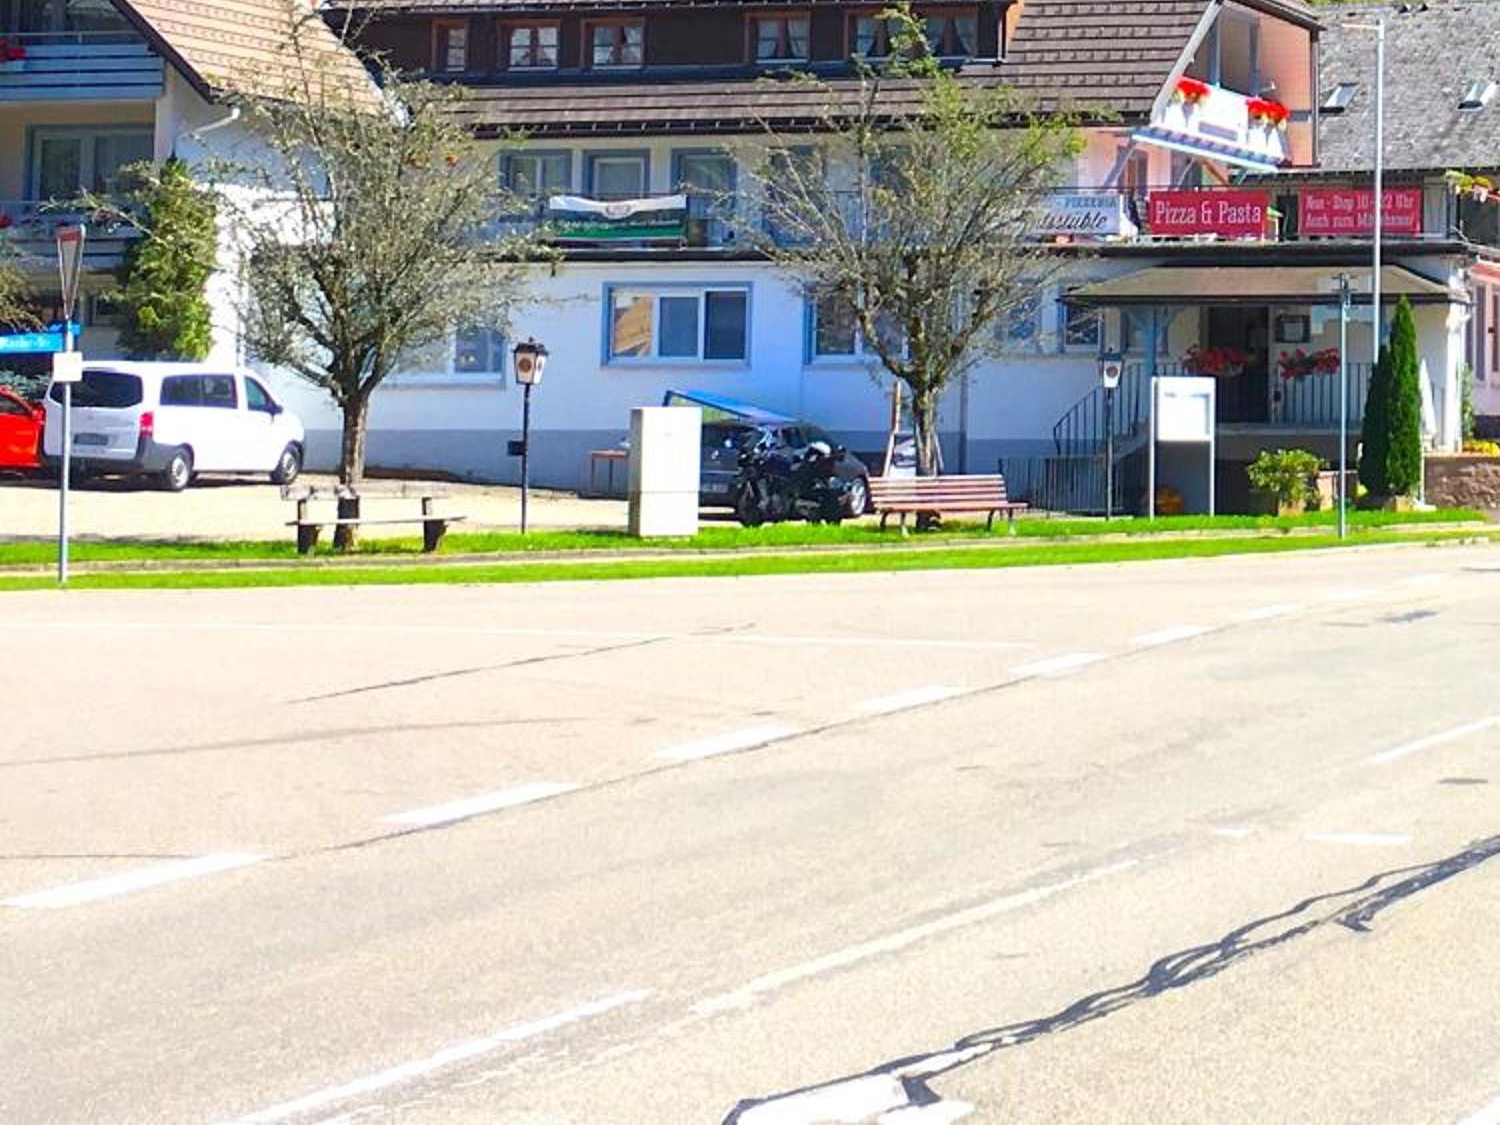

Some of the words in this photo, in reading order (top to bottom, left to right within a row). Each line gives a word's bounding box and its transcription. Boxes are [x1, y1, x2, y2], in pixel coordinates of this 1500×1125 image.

[1155, 200, 1197, 224] Pizza
[1201, 200, 1212, 224] &
[1219, 200, 1261, 224] Pasta
